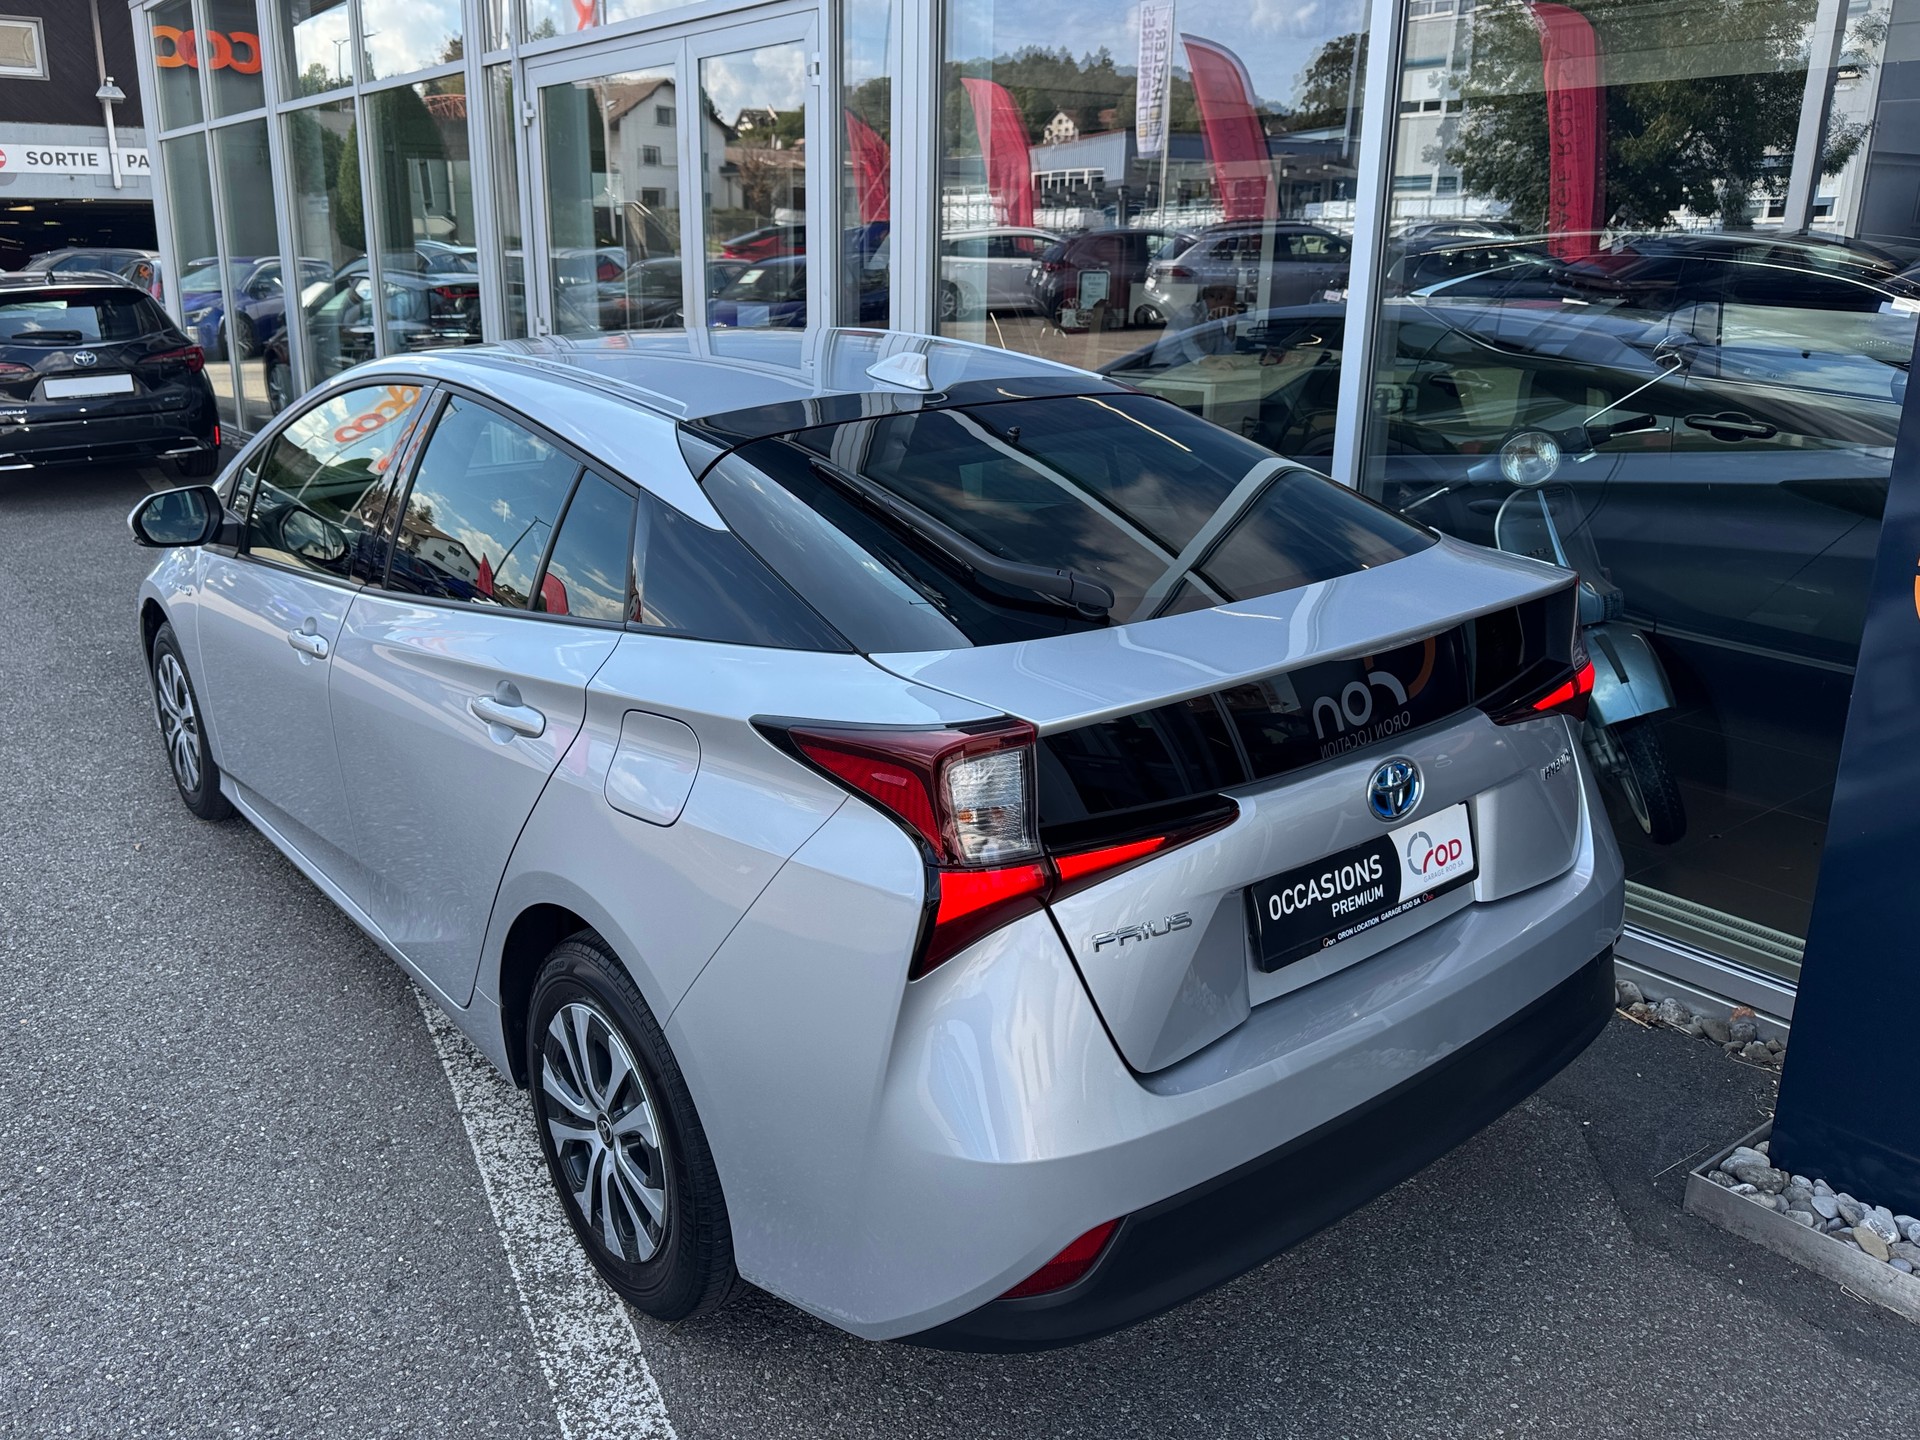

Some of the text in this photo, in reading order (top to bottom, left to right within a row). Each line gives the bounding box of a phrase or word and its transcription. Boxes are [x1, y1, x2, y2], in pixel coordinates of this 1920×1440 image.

[26, 151, 99, 167] SORTIE
[1268, 854, 1383, 921] OCCASIONS
[1423, 859, 1465, 882] GARAGE ROD SA
[1331, 884, 1384, 918] PREMIUM
[1337, 928, 1354, 940] ORON
[1354, 916, 1380, 933] LOCATION
[1380, 905, 1402, 921] GARAGE
[1402, 900, 1413, 911] ROD
[1413, 897, 1421, 906] SA
[1092, 911, 1193, 953] PRIUS
